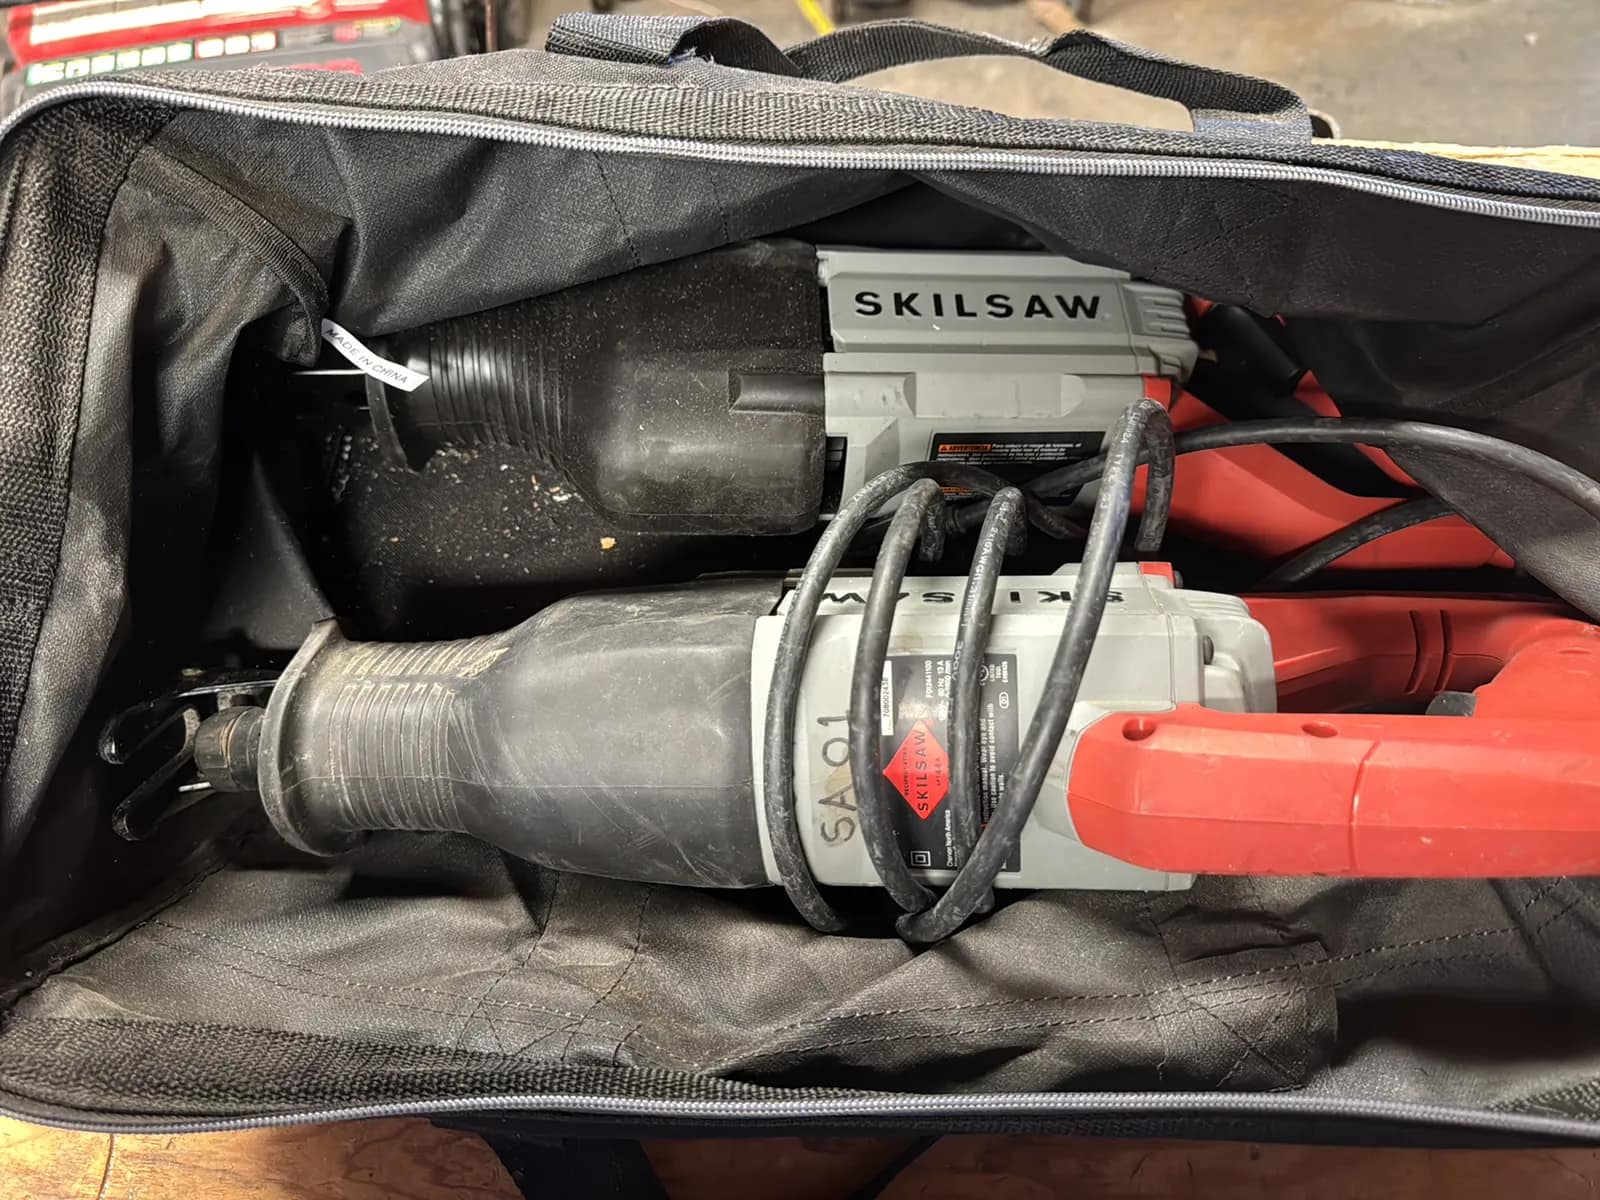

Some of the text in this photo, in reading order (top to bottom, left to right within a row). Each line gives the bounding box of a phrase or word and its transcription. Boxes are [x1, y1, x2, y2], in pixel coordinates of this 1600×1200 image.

[854, 291, 1100, 319] SKILSAW
[325, 329, 409, 384] MADE IN CHINA
[986, 703, 994, 718] with
[987, 719, 995, 744] contact
[988, 745, 996, 763] avoid
[914, 729, 929, 812] SKILSAW
[989, 773, 997, 795] caution
[945, 831, 953, 846] North
